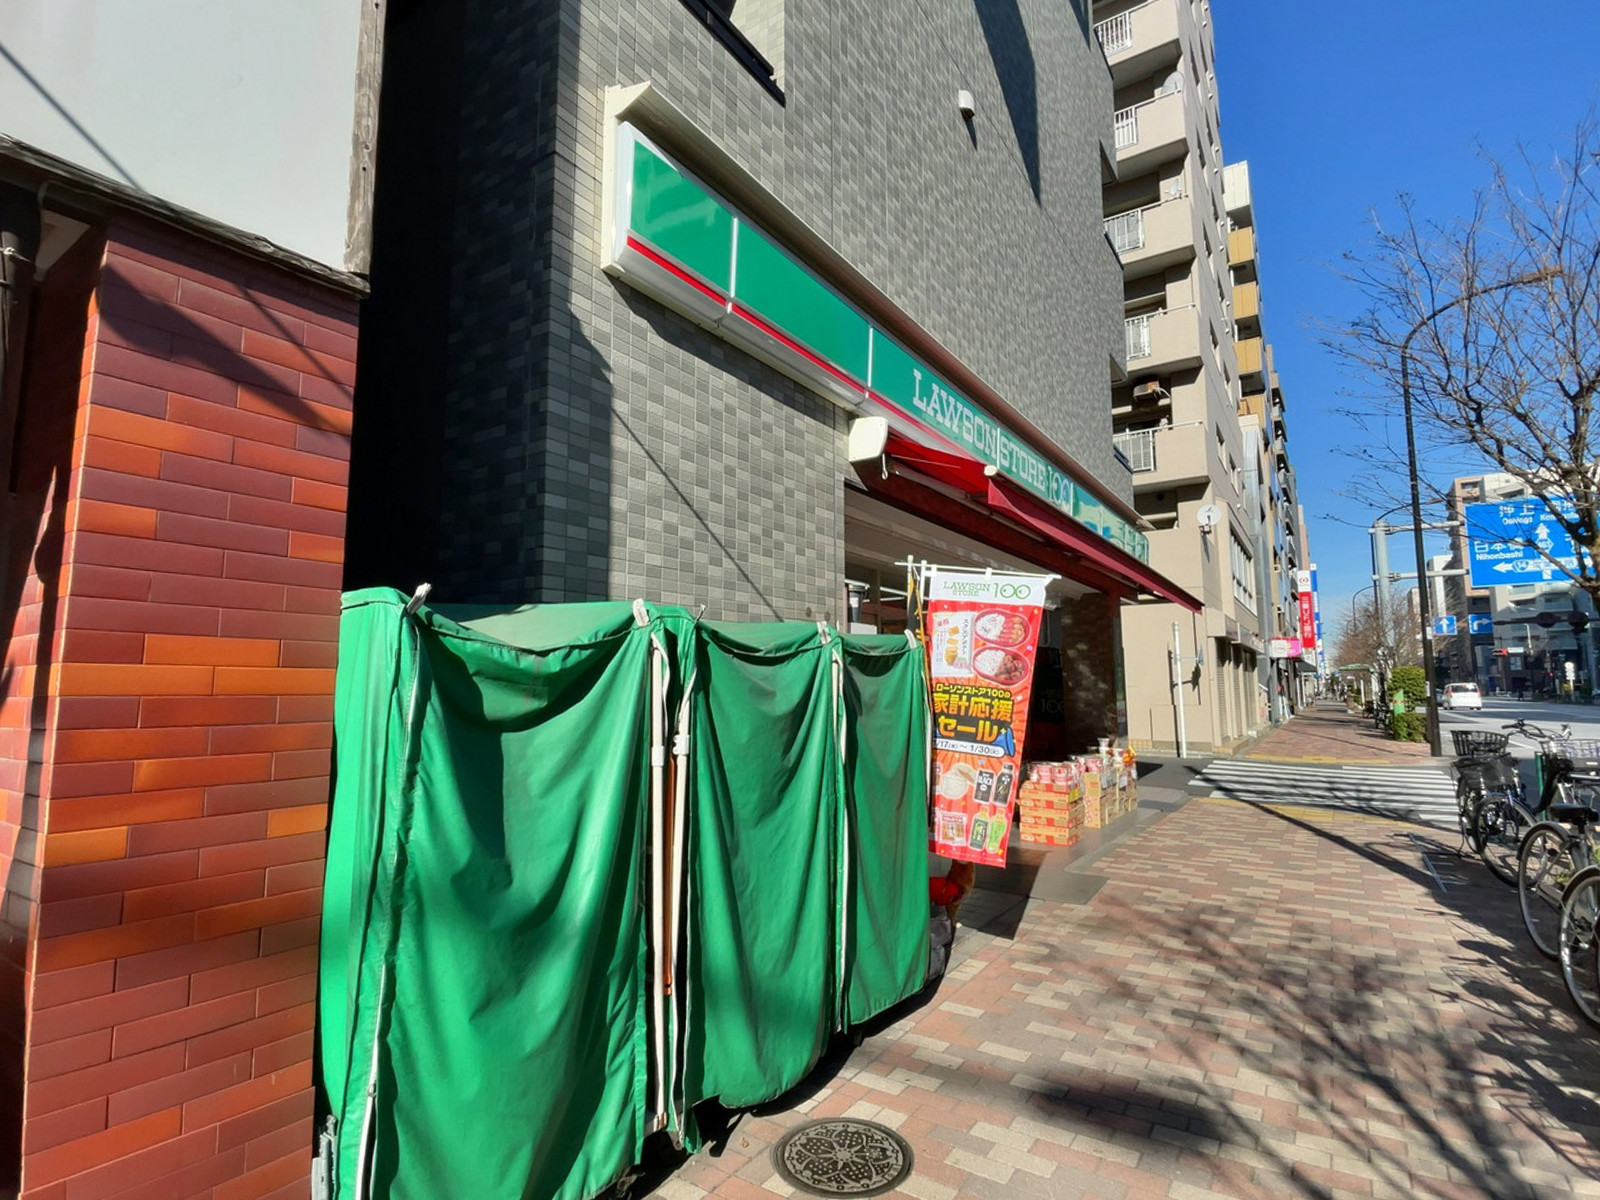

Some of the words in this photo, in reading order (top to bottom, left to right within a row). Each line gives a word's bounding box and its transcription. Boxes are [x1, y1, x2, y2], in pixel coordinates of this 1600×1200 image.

[912, 368, 998, 461] LAWSON
[1000, 434, 1046, 492] STORE
[1476, 551, 1524, 560] Nihonbashi
[943, 581, 991, 592] LAWSON
[994, 582, 1032, 600] 100
[936, 683, 1011, 699] ローソンストア100の
[933, 692, 1013, 722] 家計応援
[938, 715, 999, 743] セール
